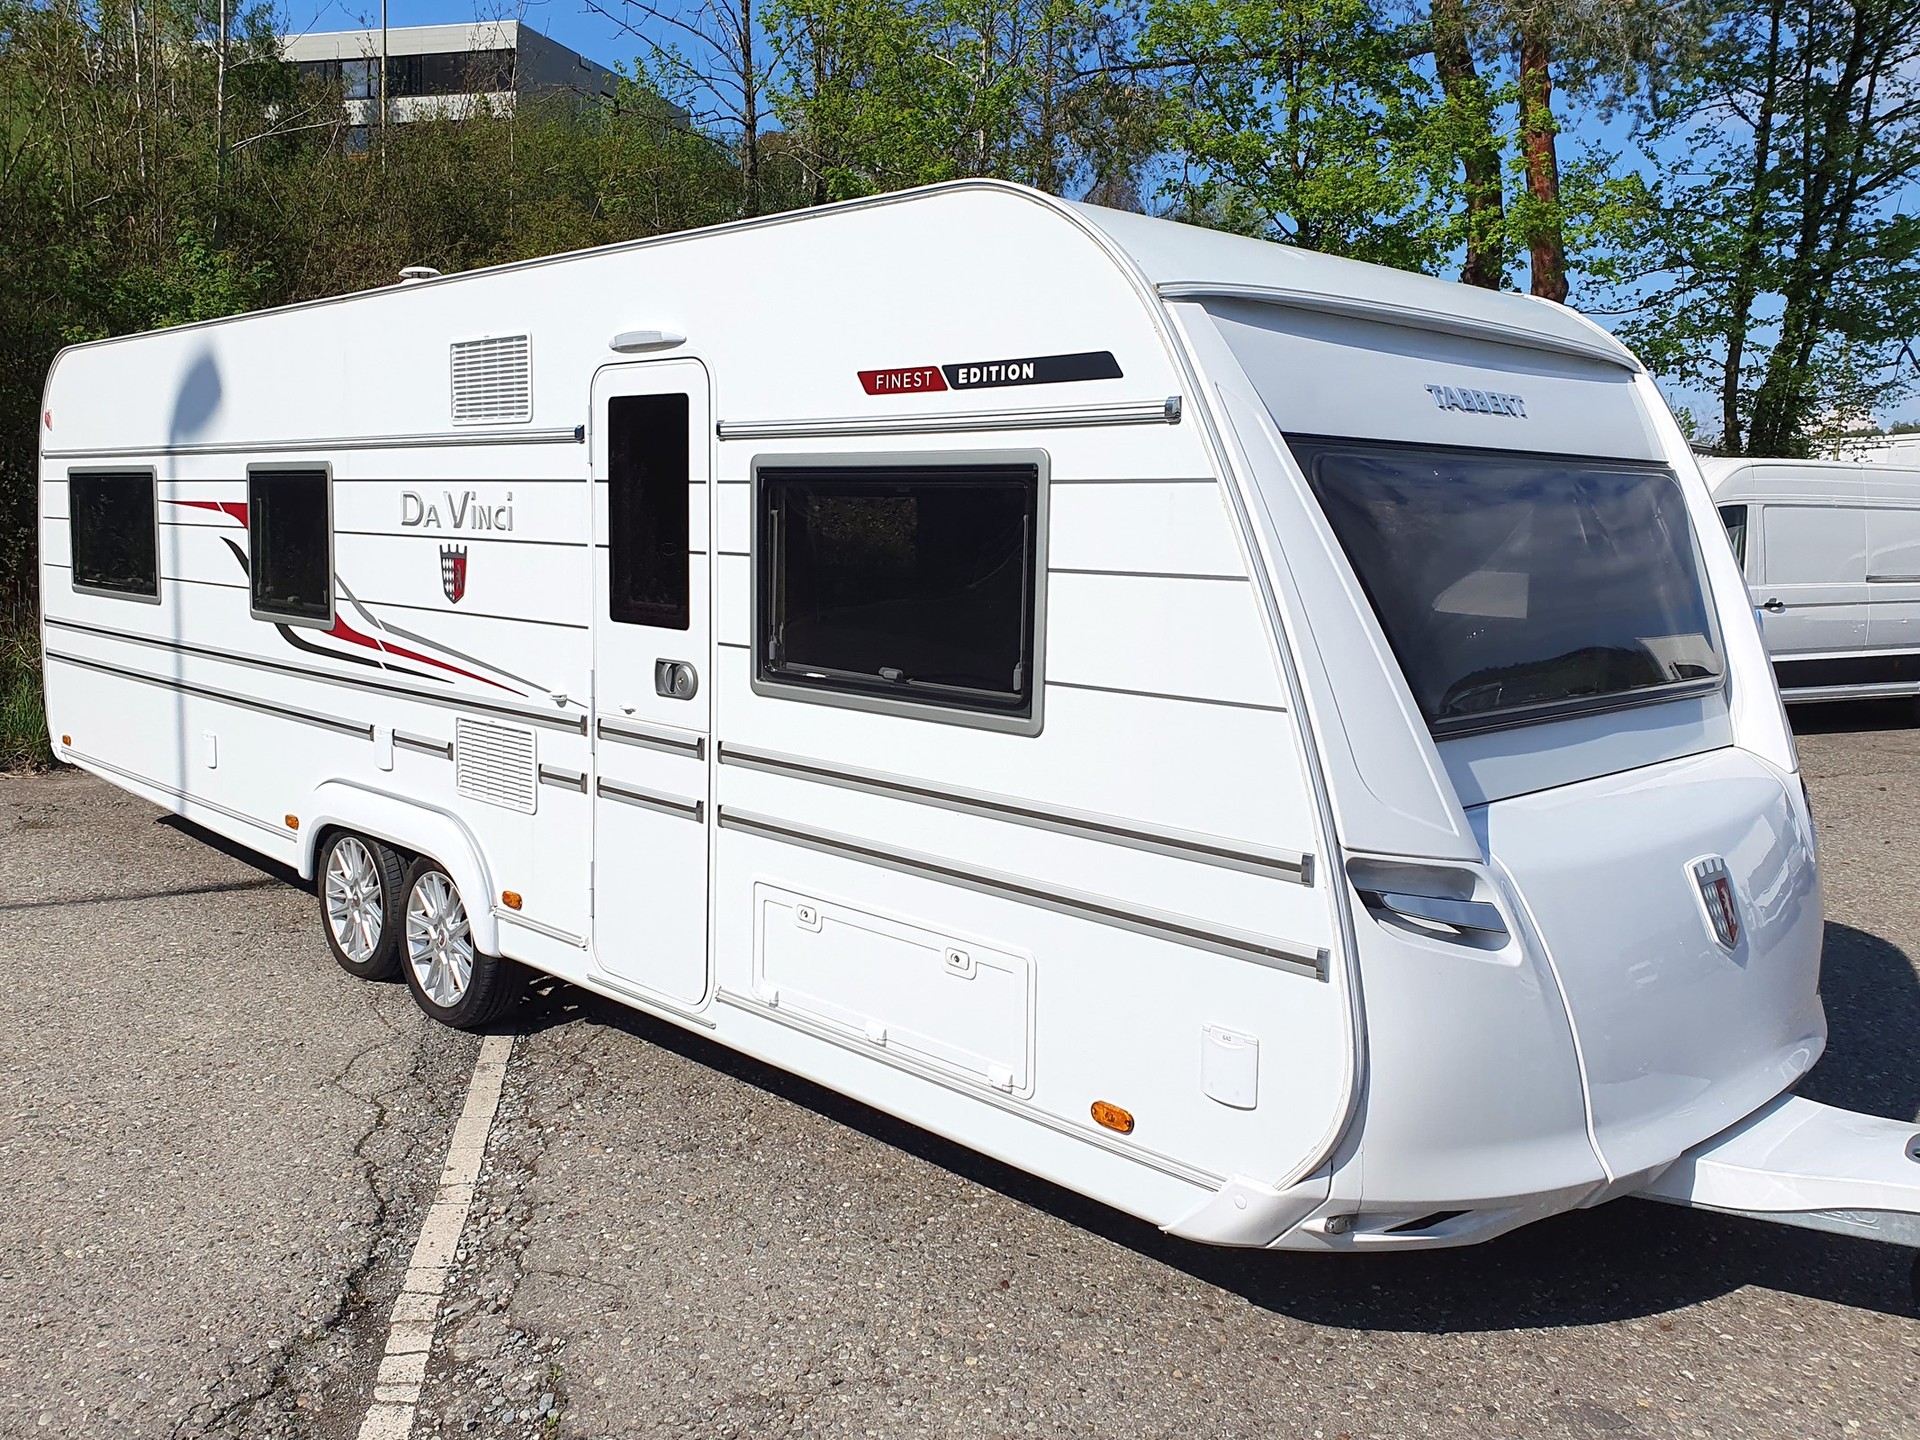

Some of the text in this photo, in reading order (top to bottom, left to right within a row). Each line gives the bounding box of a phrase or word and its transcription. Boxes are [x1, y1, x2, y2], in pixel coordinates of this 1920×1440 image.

[875, 362, 1035, 390] FINEST EDITION
[1424, 384, 1528, 419] TABBERT
